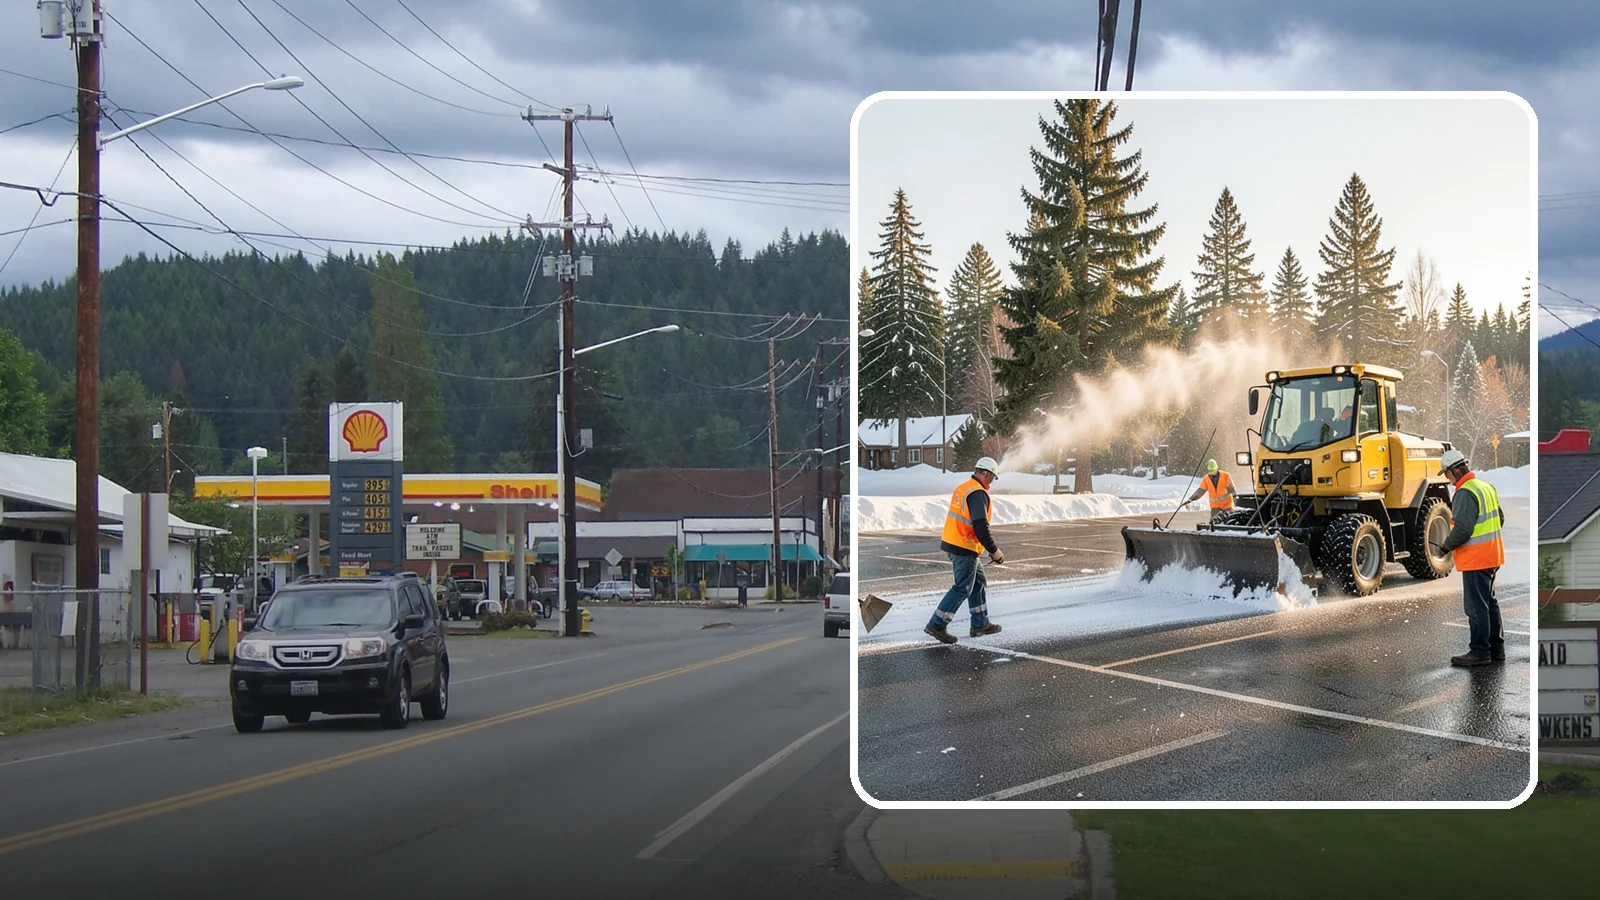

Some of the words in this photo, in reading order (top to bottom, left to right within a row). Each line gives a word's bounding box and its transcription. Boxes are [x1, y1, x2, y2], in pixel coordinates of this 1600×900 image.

[366, 480, 383, 490] 395
[490, 484, 547, 499] Shell
[366, 494, 383, 504] 405
[366, 508, 383, 518] 415
[366, 522, 383, 532] 429
